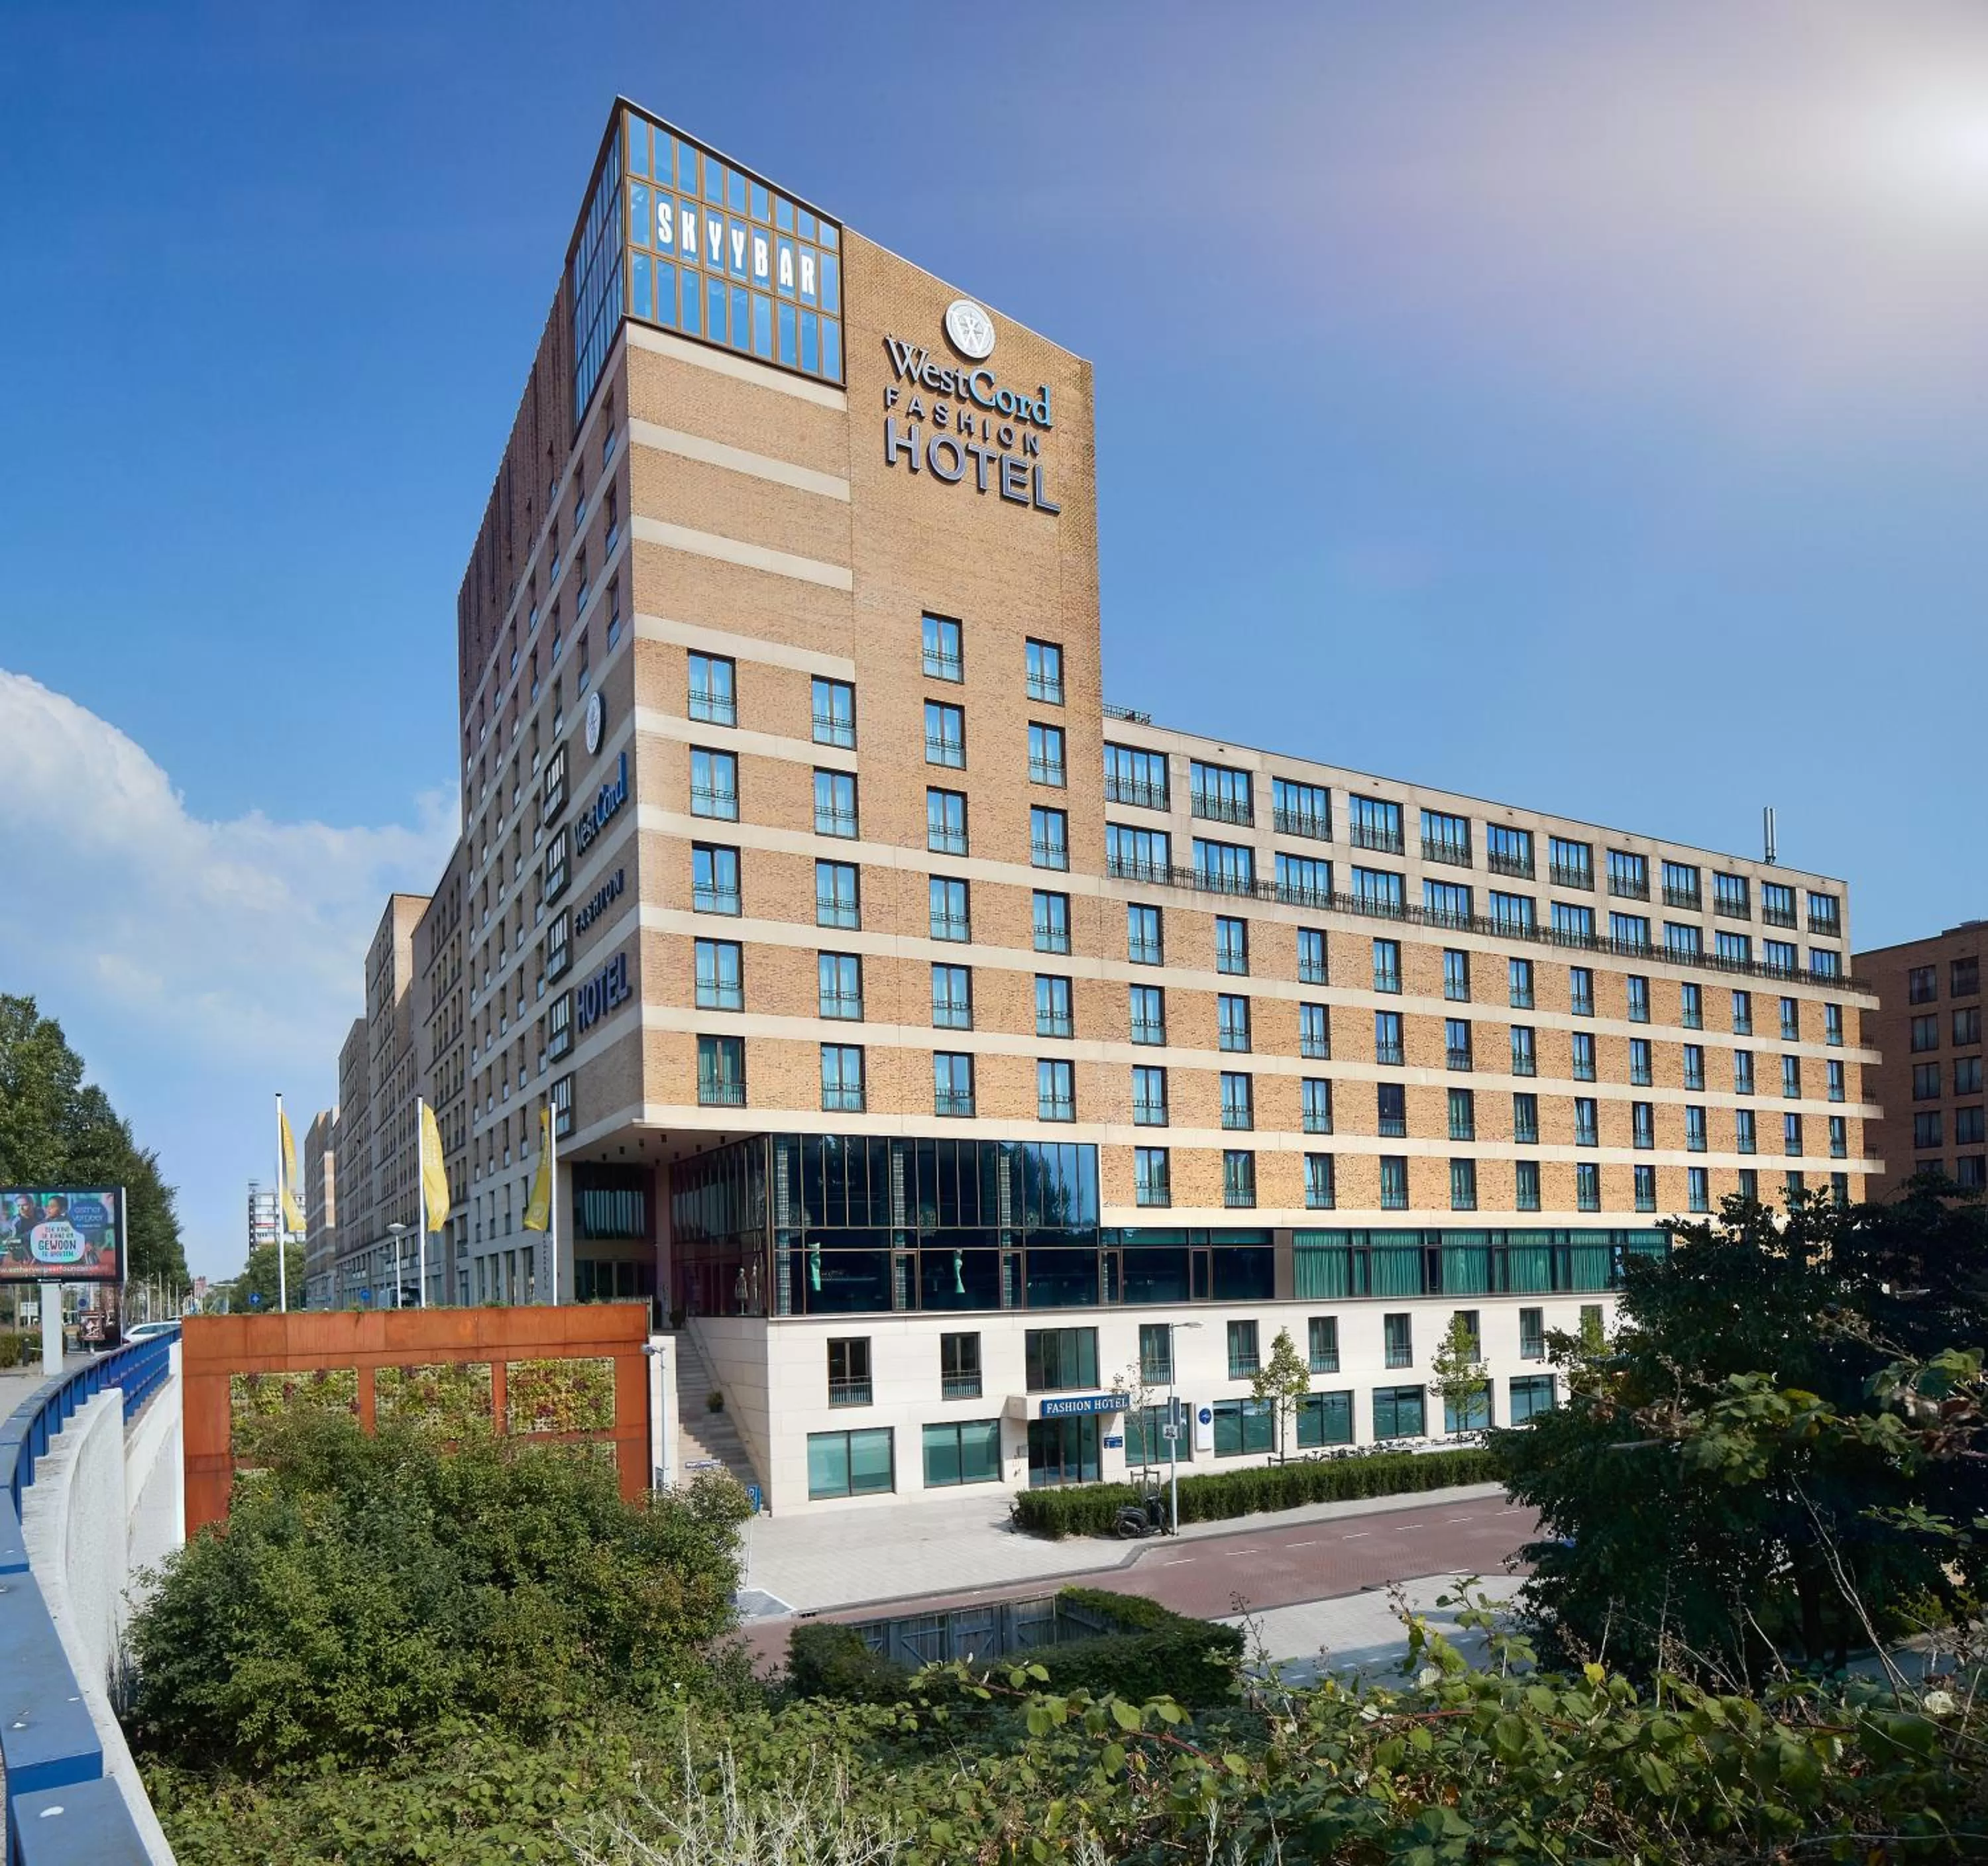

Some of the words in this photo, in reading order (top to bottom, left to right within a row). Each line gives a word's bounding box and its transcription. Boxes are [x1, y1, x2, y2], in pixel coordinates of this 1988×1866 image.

[657, 201, 815, 296] SKYYBAR
[885, 333, 1054, 428] WestCord
[885, 384, 1040, 455] FASHION
[886, 416, 1061, 513] HOTEL
[575, 952, 631, 1032] HOTEL
[38, 1240, 76, 1250] GEWOON
[1046, 1401, 1091, 1413] FASHION
[1094, 1398, 1127, 1409] HOTEL
